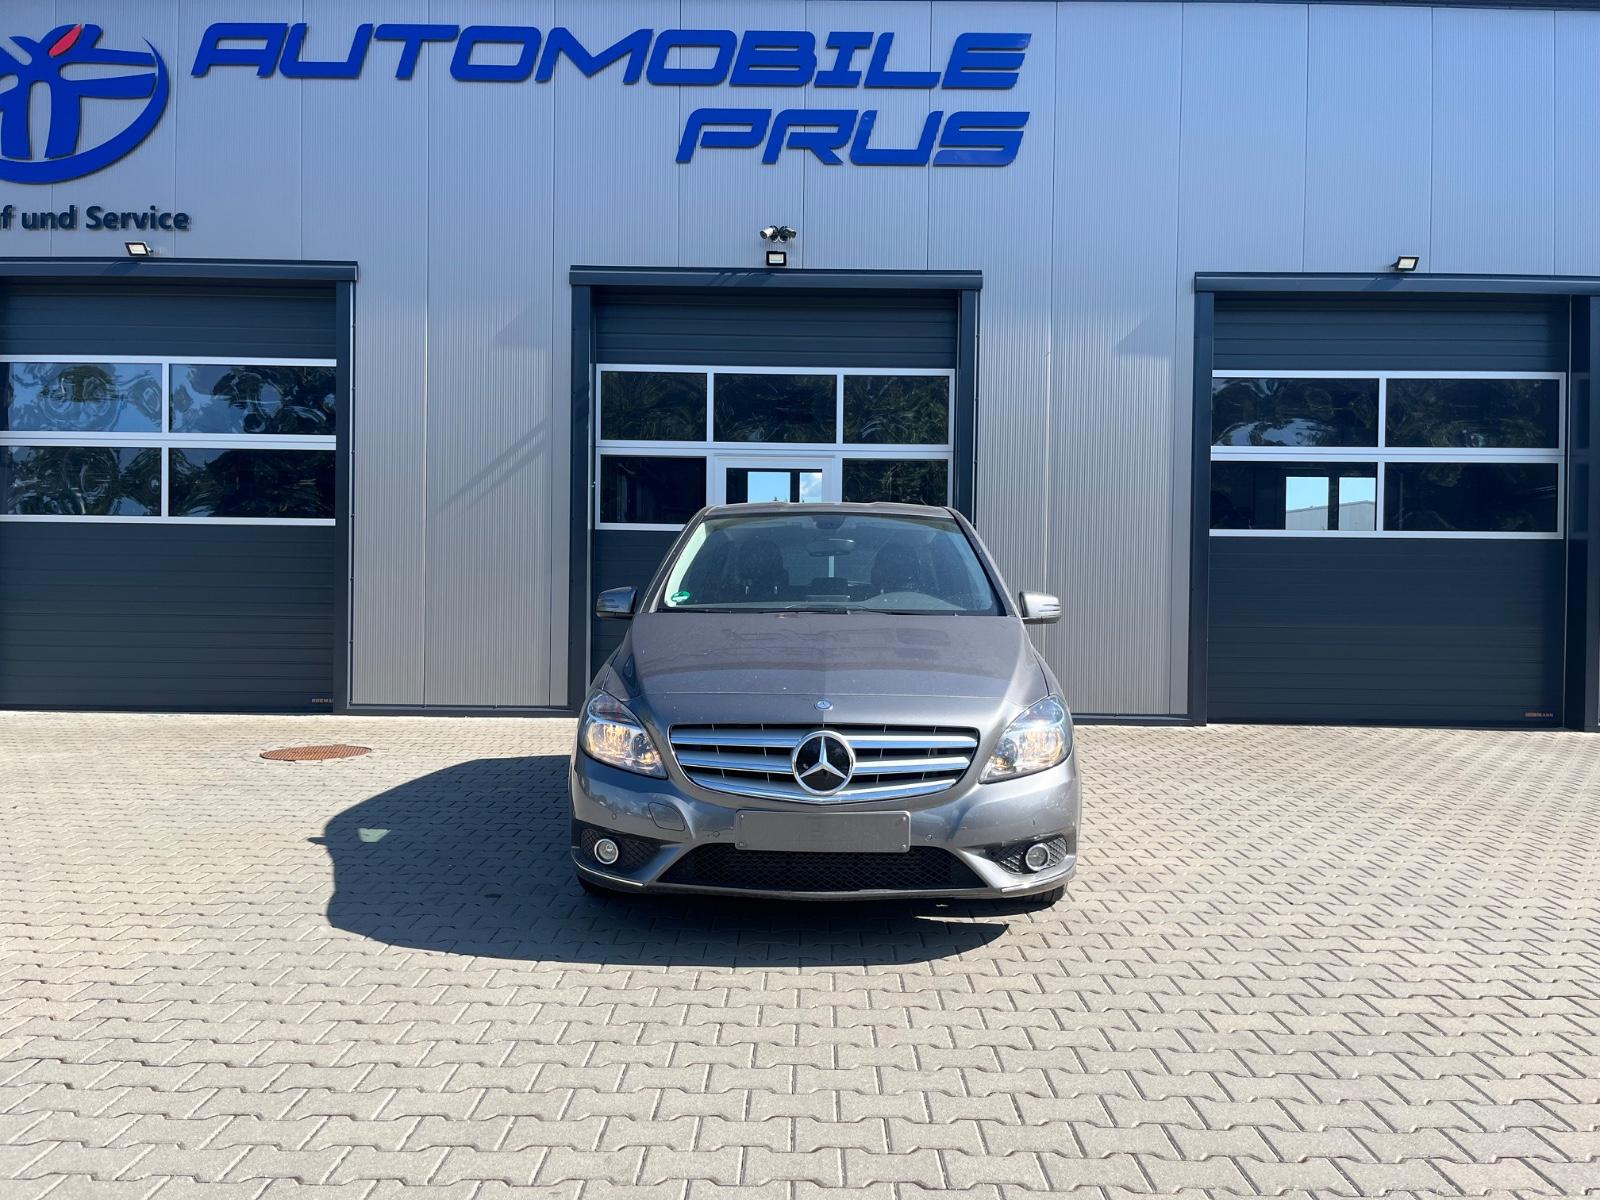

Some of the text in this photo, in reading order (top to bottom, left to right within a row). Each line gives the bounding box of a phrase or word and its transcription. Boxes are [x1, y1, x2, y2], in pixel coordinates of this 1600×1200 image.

[191, 23, 1031, 89] AUTOMOBILE
[675, 108, 1030, 167] PRUS
[0, 204, 190, 231] f und Service
